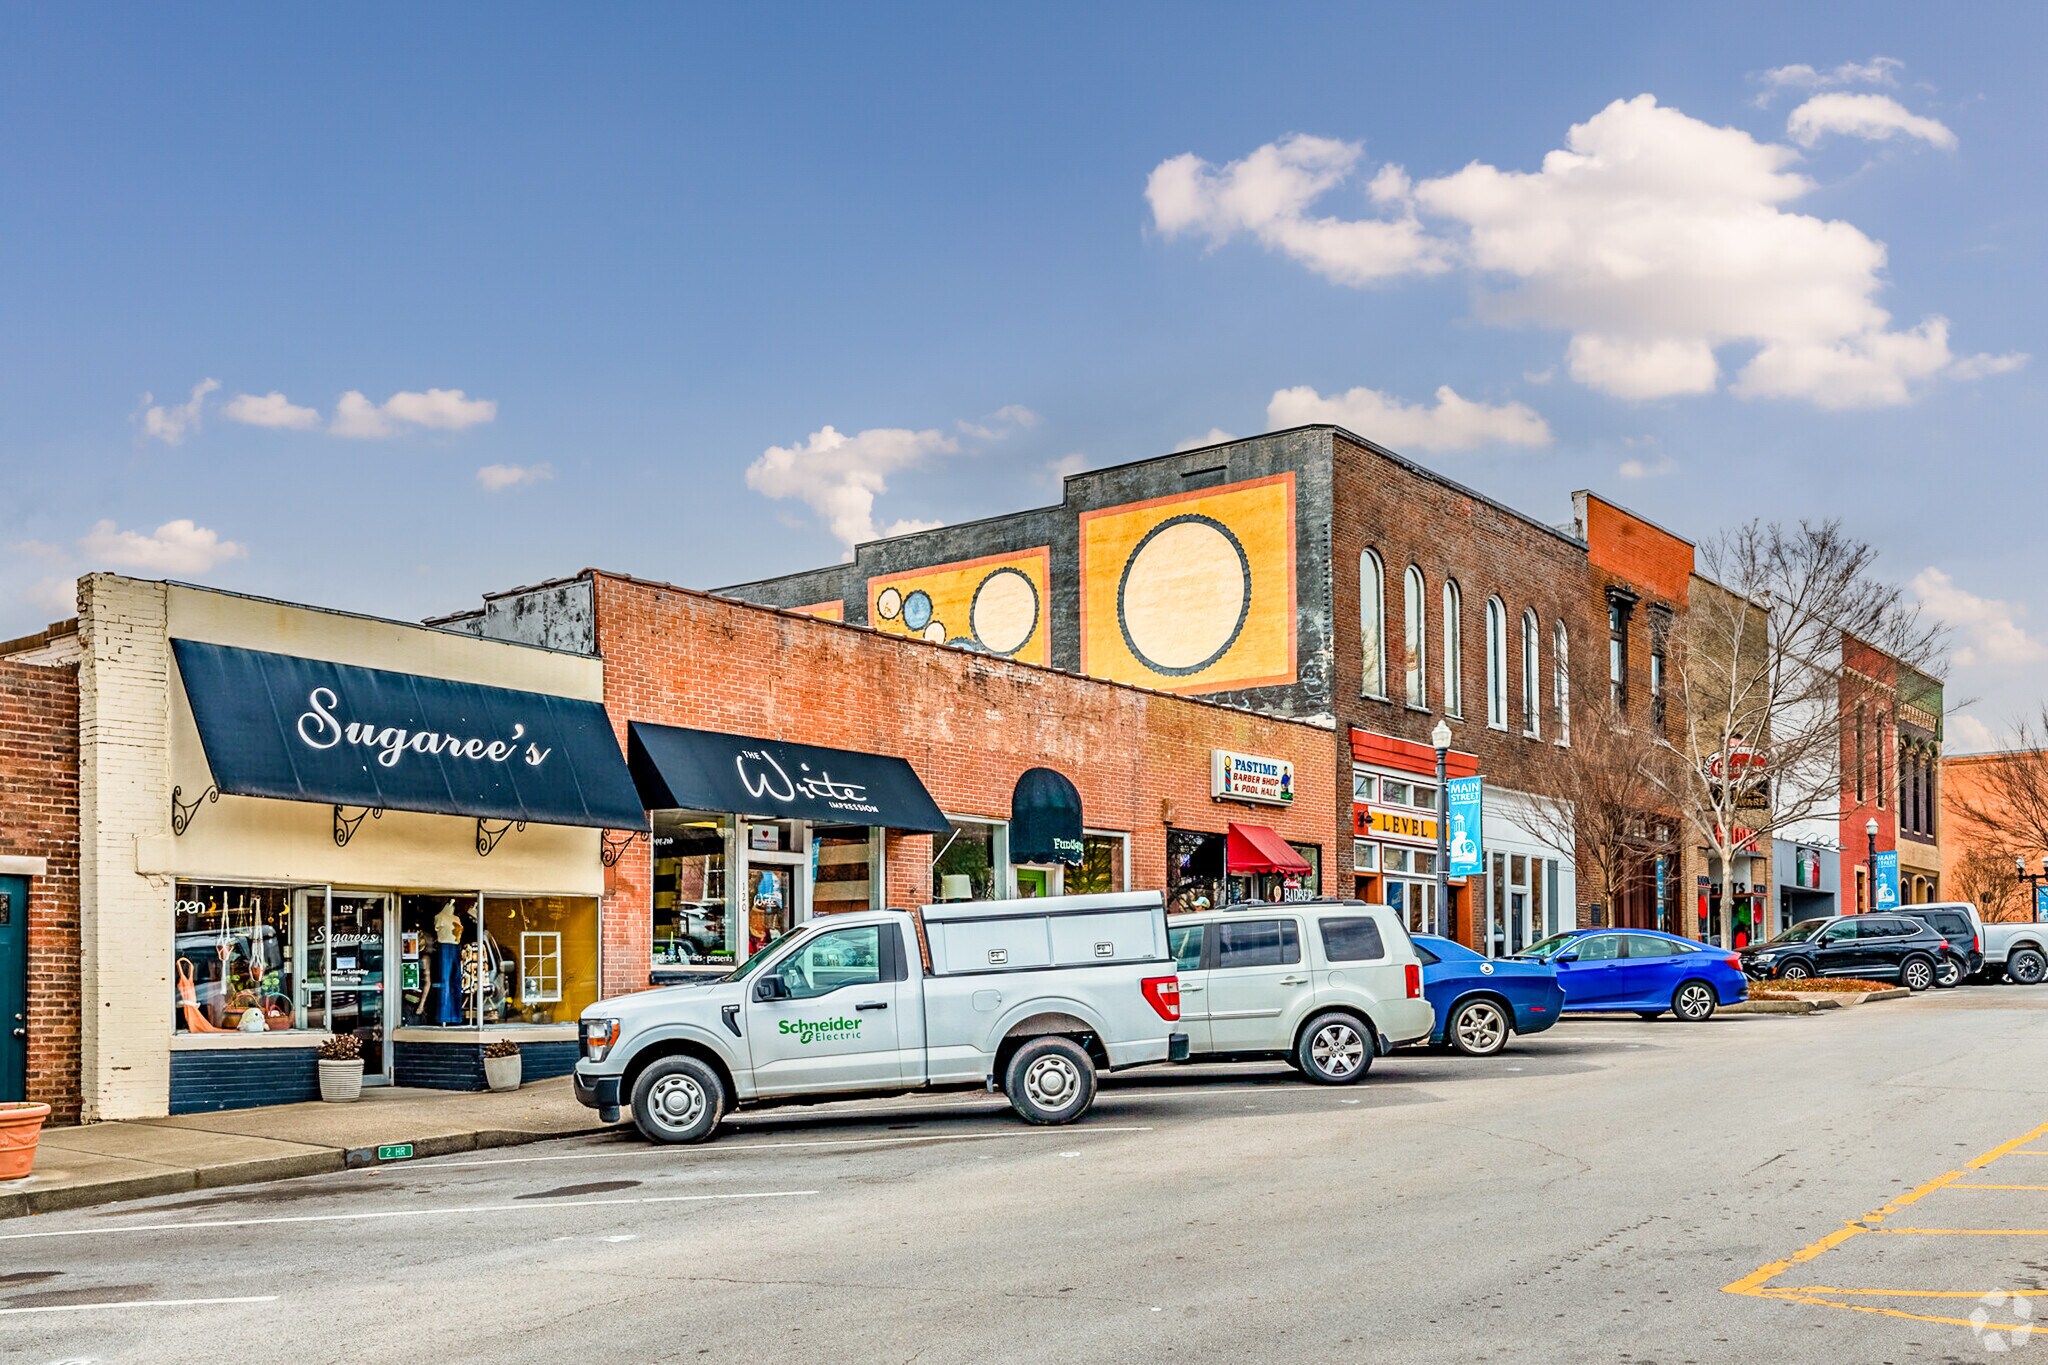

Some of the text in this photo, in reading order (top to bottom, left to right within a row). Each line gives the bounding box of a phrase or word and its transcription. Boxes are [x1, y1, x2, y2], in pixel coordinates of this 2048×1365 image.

[297, 687, 551, 767] Sugaree's
[742, 750, 762, 760] THE
[1235, 759, 1278, 776] PASTIME
[736, 750, 867, 802] Write
[1233, 773, 1279, 786] BARBER SHOP
[1242, 784, 1259, 795] POOL
[1260, 788, 1277, 797] HALL
[1450, 782, 1479, 794] MAIN
[1450, 791, 1480, 802] STREET
[828, 801, 879, 813] IMPRESSION
[1382, 815, 1428, 837] LEVEL
[1710, 882, 1746, 894] GITS
[314, 926, 379, 948] Sgaree's
[706, 953, 733, 964] presents
[778, 1016, 862, 1035] Schneider
[815, 1032, 862, 1042] Electric
[385, 1146, 406, 1157] 2 HR
